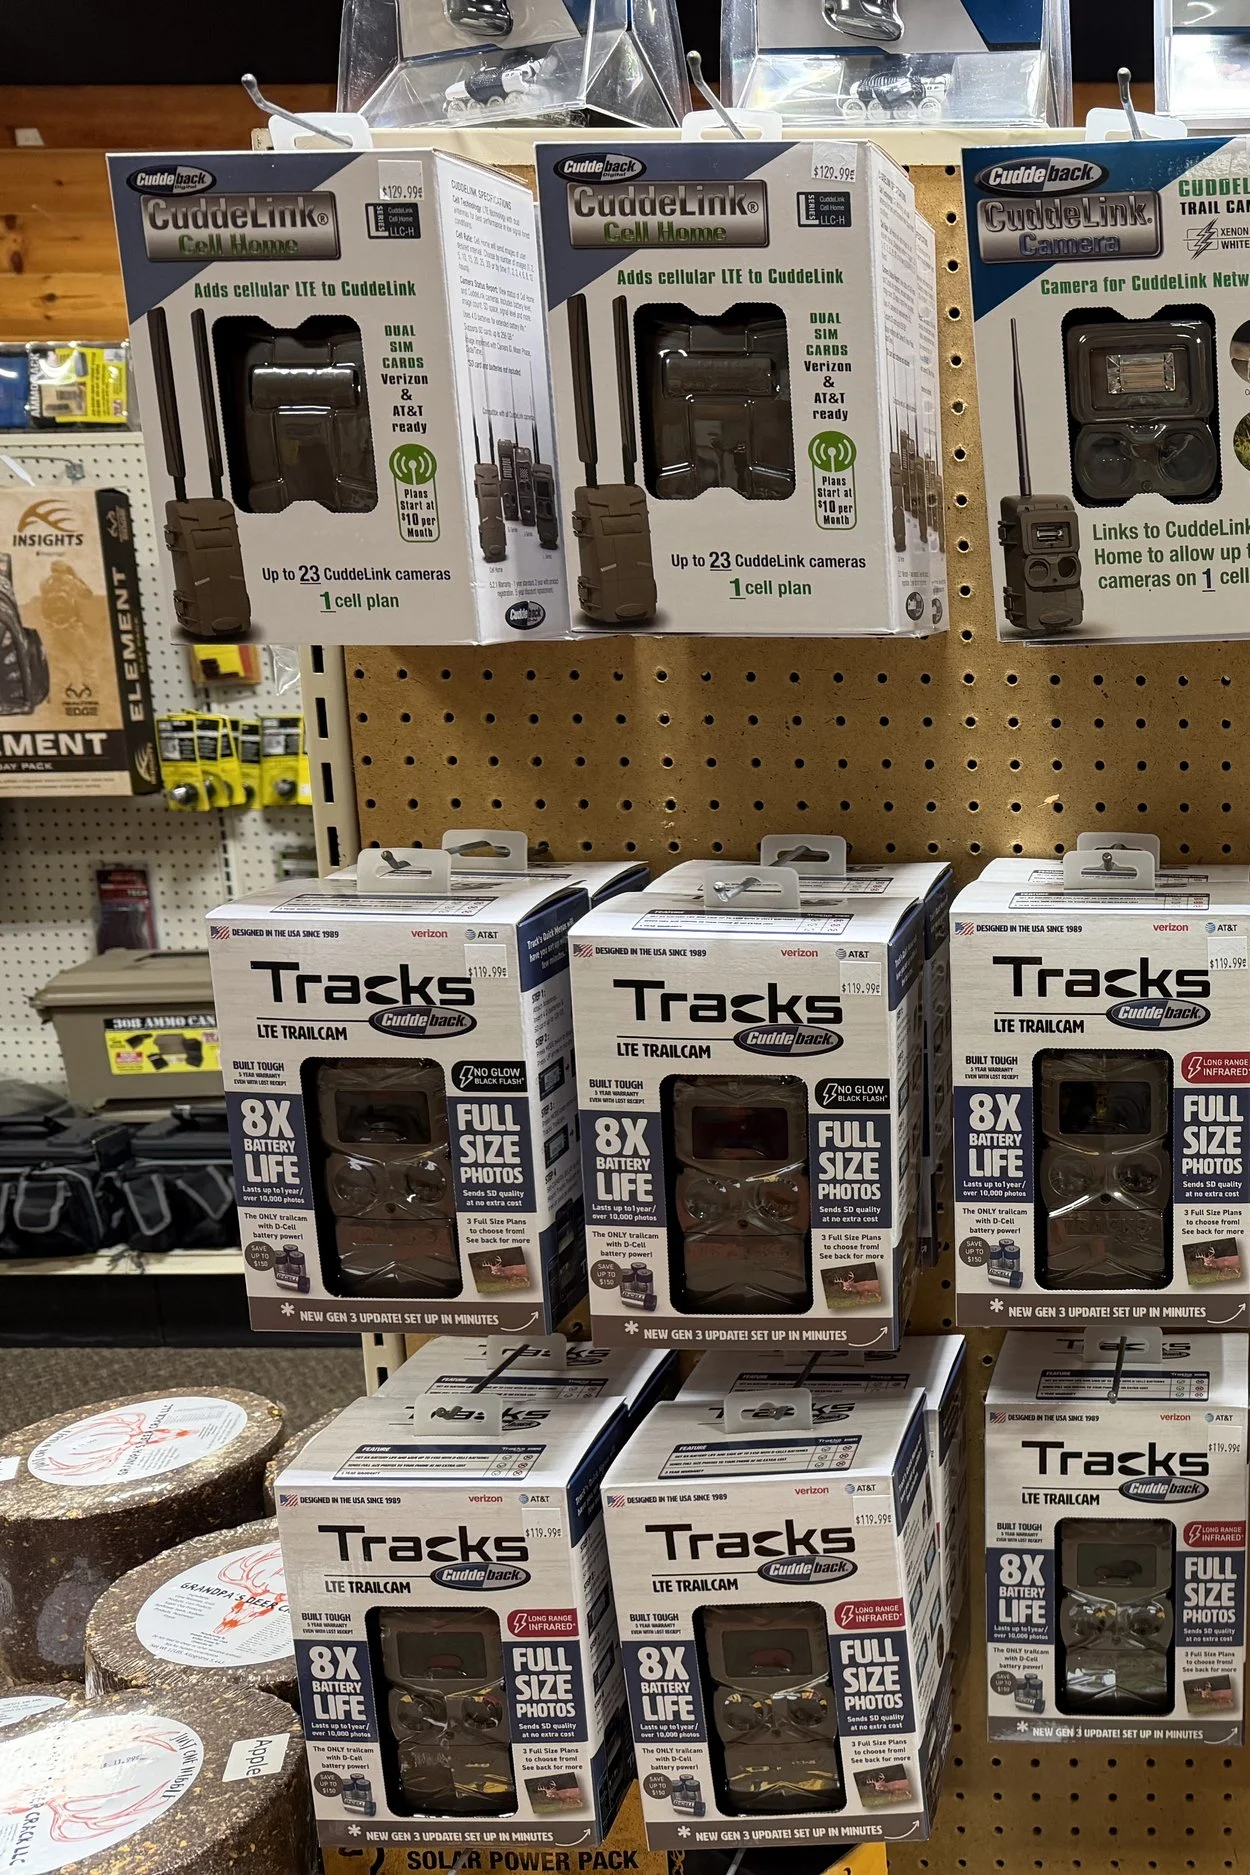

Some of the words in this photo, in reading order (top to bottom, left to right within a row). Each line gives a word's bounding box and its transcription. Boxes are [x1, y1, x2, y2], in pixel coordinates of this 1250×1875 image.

[563, 158, 637, 175] Cuddeback
[137, 170, 207, 186] Cuddeback
[1180, 201, 1220, 215] TRAIL
[390, 226, 415, 237] LLC-H
[1220, 227, 1248, 237] XENON
[178, 233, 223, 256] Cell
[231, 233, 298, 256] Home
[1221, 239, 1250, 249] WHITE
[194, 283, 228, 298] Adds
[233, 282, 289, 298] cellular
[295, 281, 316, 296] LTE
[322, 282, 337, 297] to
[342, 281, 416, 296] CuddeLink
[385, 325, 416, 336] DUAL
[390, 341, 413, 352] SIM
[382, 357, 424, 369] CARDS
[381, 373, 428, 386] Verizon
[401, 389, 412, 400] &
[393, 405, 424, 417] AT&T
[392, 420, 427, 435] ready
[1092, 523, 1138, 541] Links
[1144, 522, 1160, 539] to
[13, 533, 84, 548] INSIGHTS
[1095, 547, 1143, 565] Home
[1148, 547, 1164, 563] to
[1169, 545, 1214, 562] allow
[1220, 545, 1241, 565] up
[262, 568, 278, 582] Up
[283, 568, 295, 581] to
[300, 565, 320, 583] 23
[323, 568, 391, 581] CuddeLink
[395, 568, 451, 581] cameras
[1098, 572, 1171, 589] cameras
[1176, 572, 1196, 587] on
[1202, 569, 1215, 592] 1
[1220, 567, 1249, 585] cell
[321, 591, 335, 611] 1
[335, 595, 362, 608] cell
[367, 593, 399, 610] plan
[111, 568, 145, 722] ELEMENT
[0, 732, 107, 756] MENT
[21, 762, 53, 770] PACK
[411, 929, 448, 938] verizon
[976, 925, 1008, 933] DESIGNED
[1010, 925, 1017, 933] IN
[1018, 925, 1030, 933] THE
[1032, 925, 1044, 933] USA
[1046, 925, 1064, 933] SINCE
[1065, 925, 1082, 933] 1989
[1153, 923, 1188, 932] verizon
[251, 961, 475, 1005] Tracks
[993, 956, 1211, 998] Tracks
[1118, 1006, 1201, 1019] Cuddeback
[145, 1016, 183, 1028] AMMO
[187, 1015, 216, 1027] CAN
[994, 1020, 1014, 1033] LTE
[1018, 1020, 1084, 1034] TRAILCAM
[966, 1056, 987, 1065] BUILT
[991, 1056, 1018, 1065] TOUGH
[1204, 1059, 1220, 1067] LONG
[474, 1068, 488, 1077] NO
[490, 1068, 520, 1078] GLOW
[969, 1094, 1022, 1132] 8X
[1183, 1095, 1243, 1122] FULL
[969, 1134, 1022, 1147] BATTERY
[1183, 1126, 1241, 1155] SIZE
[969, 1149, 1023, 1178] LIFE
[1182, 1158, 1242, 1175] PHOTOS
[1218, 1181, 1242, 1190] quality
[1009, 1307, 1033, 1317] NEW
[1035, 1307, 1055, 1317] GEN
[1059, 1307, 1066, 1317] 3
[1069, 1307, 1110, 1317] UPDATE!
[1113, 1307, 1131, 1317] SET
[1134, 1307, 1147, 1318] UP
[1150, 1307, 1160, 1318] IN
[1163, 1307, 1206, 1318] MINUTES
[180, 1583, 245, 1601] GRANDPA'S
[246, 1739, 273, 1776] Apple
[408, 1851, 481, 1871] SOLAR
[490, 1852, 570, 1871] POWER
[578, 1851, 638, 1868] PACK
